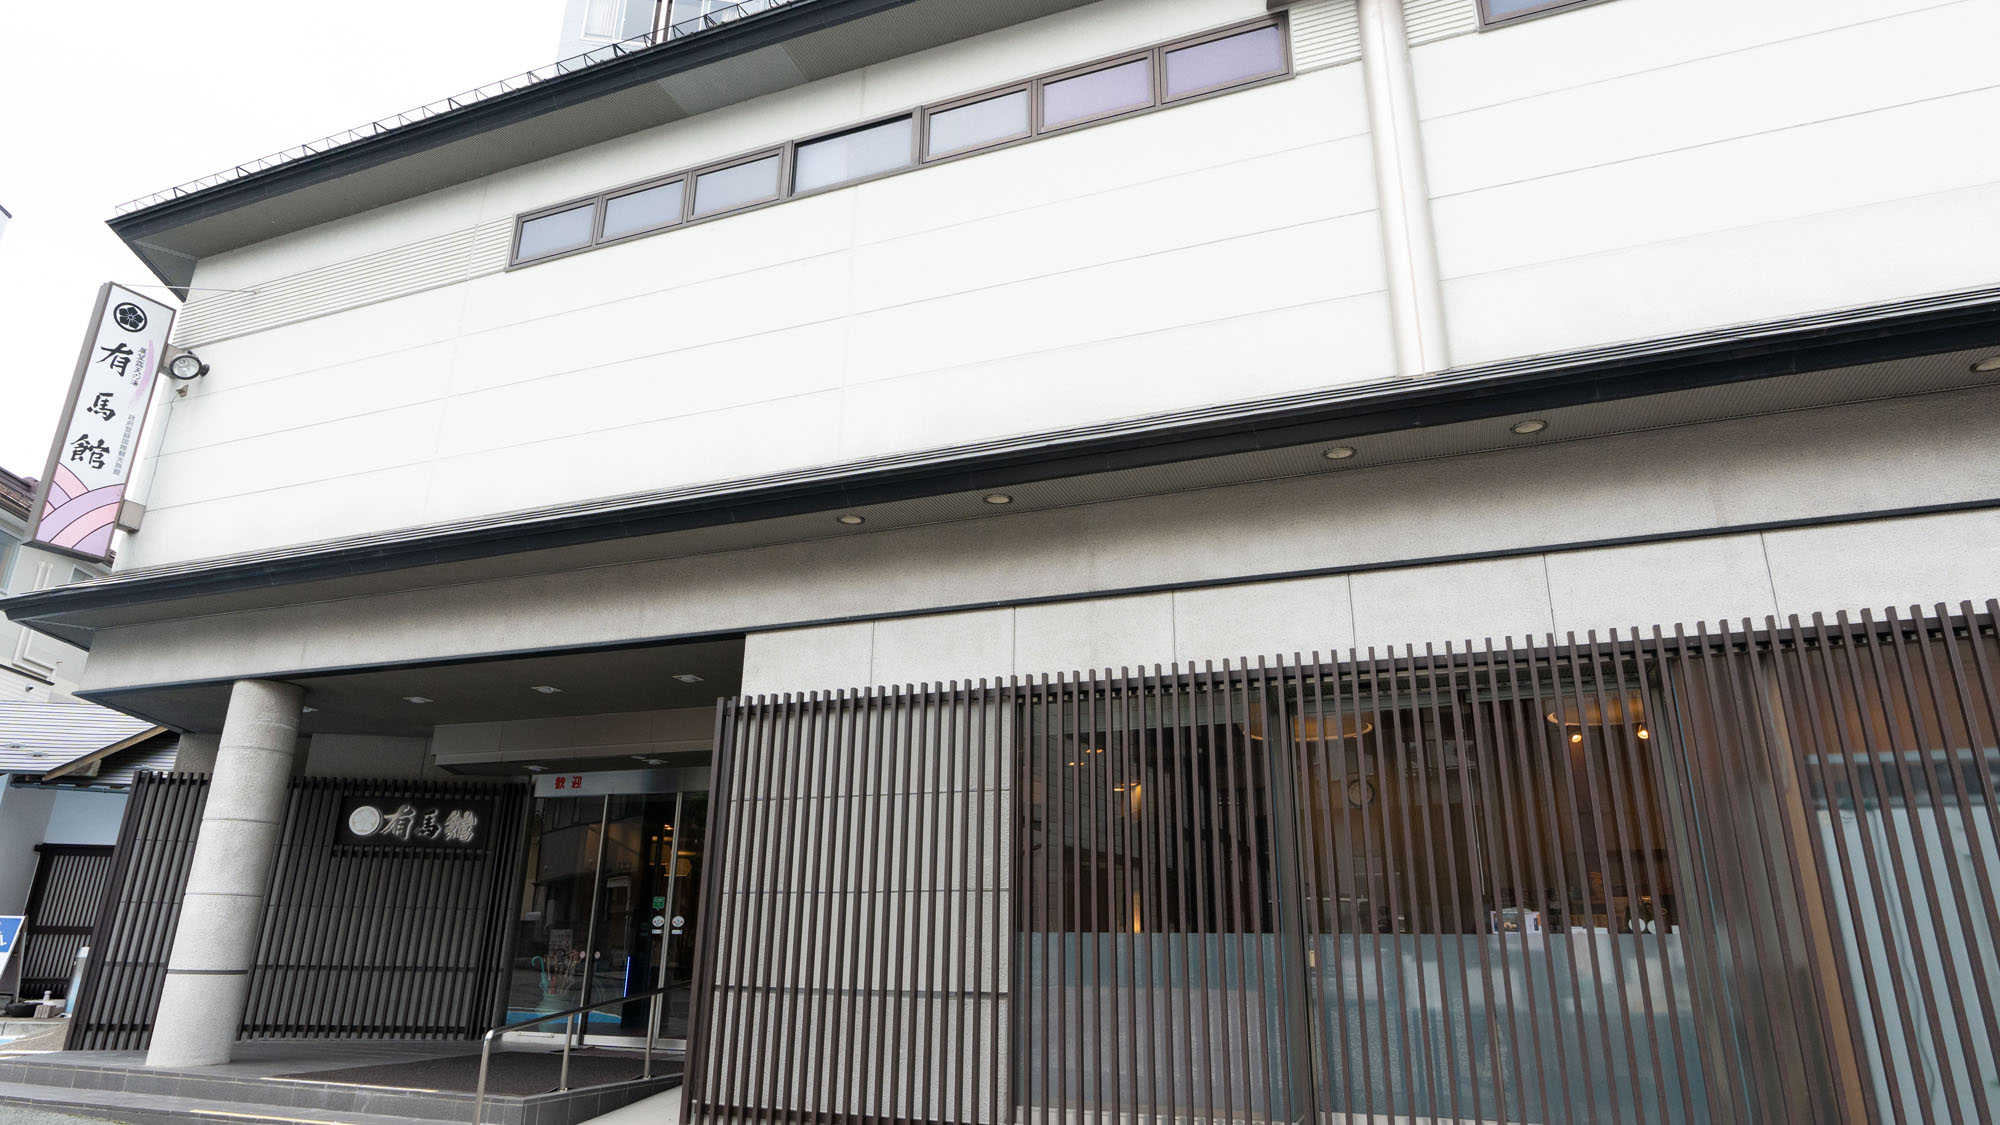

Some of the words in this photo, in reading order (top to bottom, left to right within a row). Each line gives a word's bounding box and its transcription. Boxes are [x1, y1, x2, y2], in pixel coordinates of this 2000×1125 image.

[71, 343, 133, 470] 有馬館
[555, 776, 582, 790] 歓迎
[380, 804, 477, 842] 有馬館
